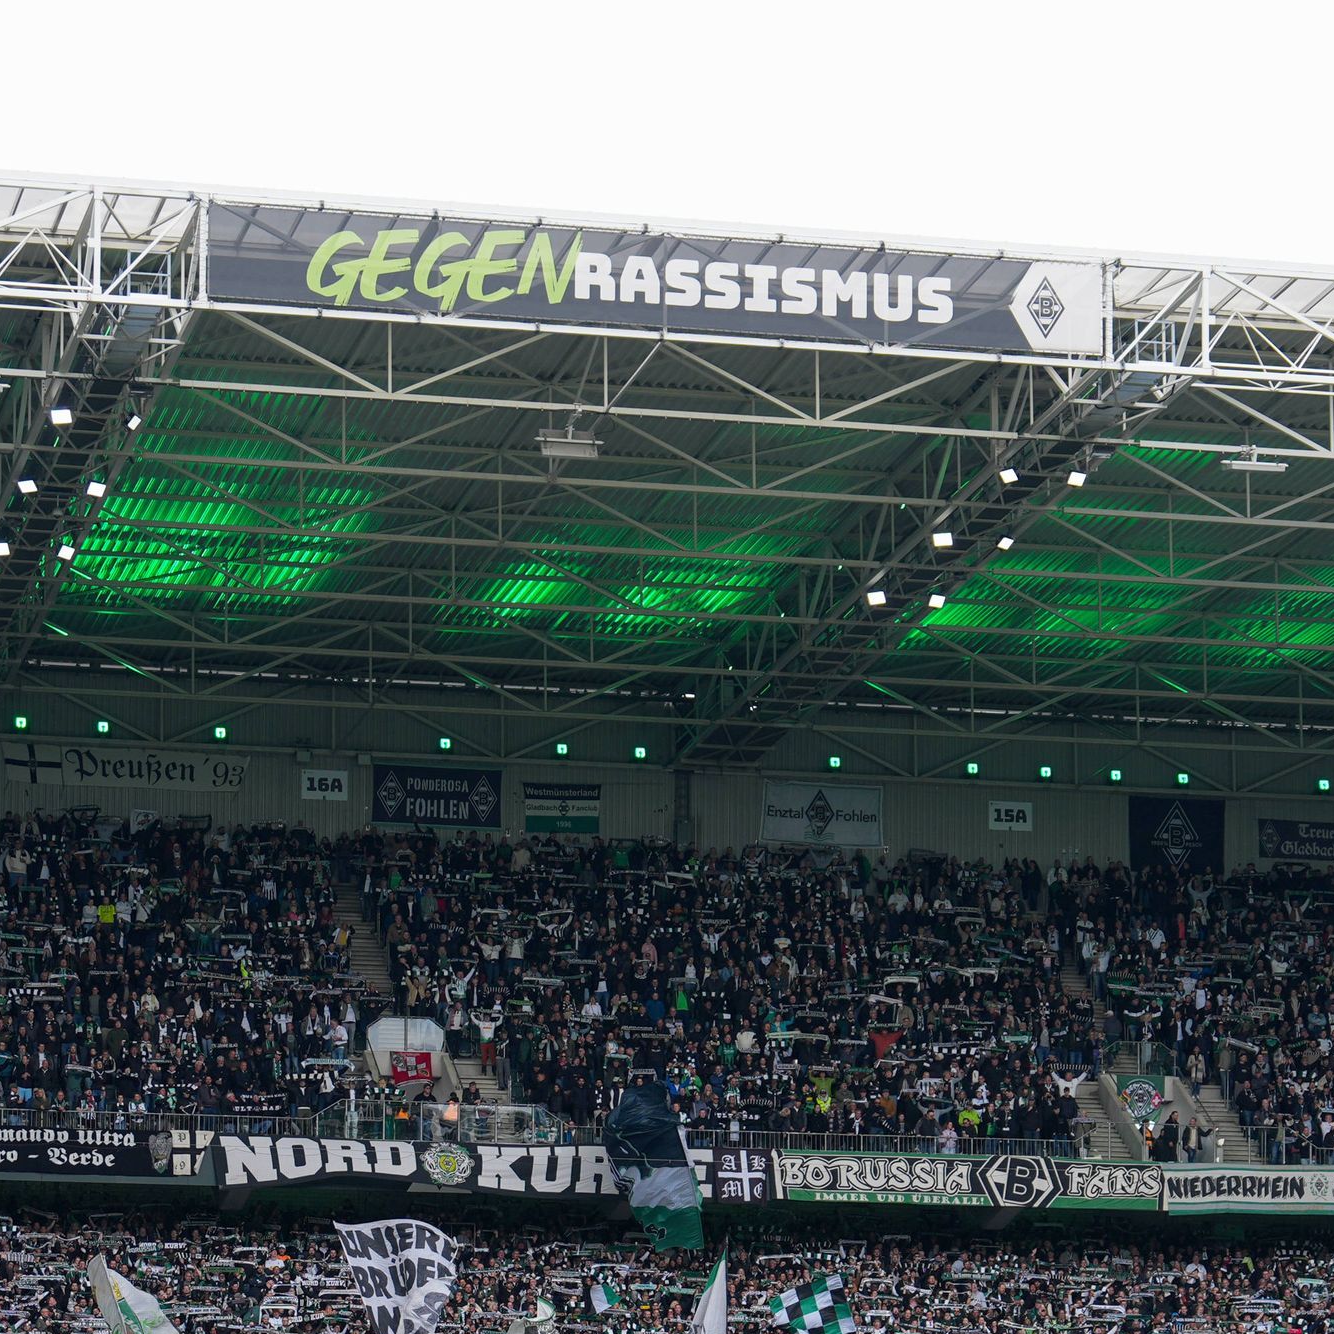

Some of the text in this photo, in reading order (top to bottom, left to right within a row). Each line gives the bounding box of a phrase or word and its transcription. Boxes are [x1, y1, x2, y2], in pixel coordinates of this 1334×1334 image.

[307, 228, 954, 323] GEGEN RASSISMUS
[65, 749, 195, 785] Preußen
[307, 778, 343, 793] 16A
[407, 777, 469, 797] PONDEROSA
[525, 786, 599, 798] Westmünsterland
[405, 797, 469, 820] FOHLEN
[767, 804, 877, 823] Enztal Fohlen
[993, 808, 1027, 824] 15A
[76, 1129, 137, 1148] Ultra
[47, 1147, 116, 1168] Verde
[219, 1136, 713, 1198] NORD KURE
[779, 1155, 972, 1194] BORUSSIA
[1066, 1164, 1162, 1198] FANS
[1167, 1175, 1306, 1201] NIEDERRHEIN
[815, 1192, 984, 1206] IMMER UND ÜBERALL!
